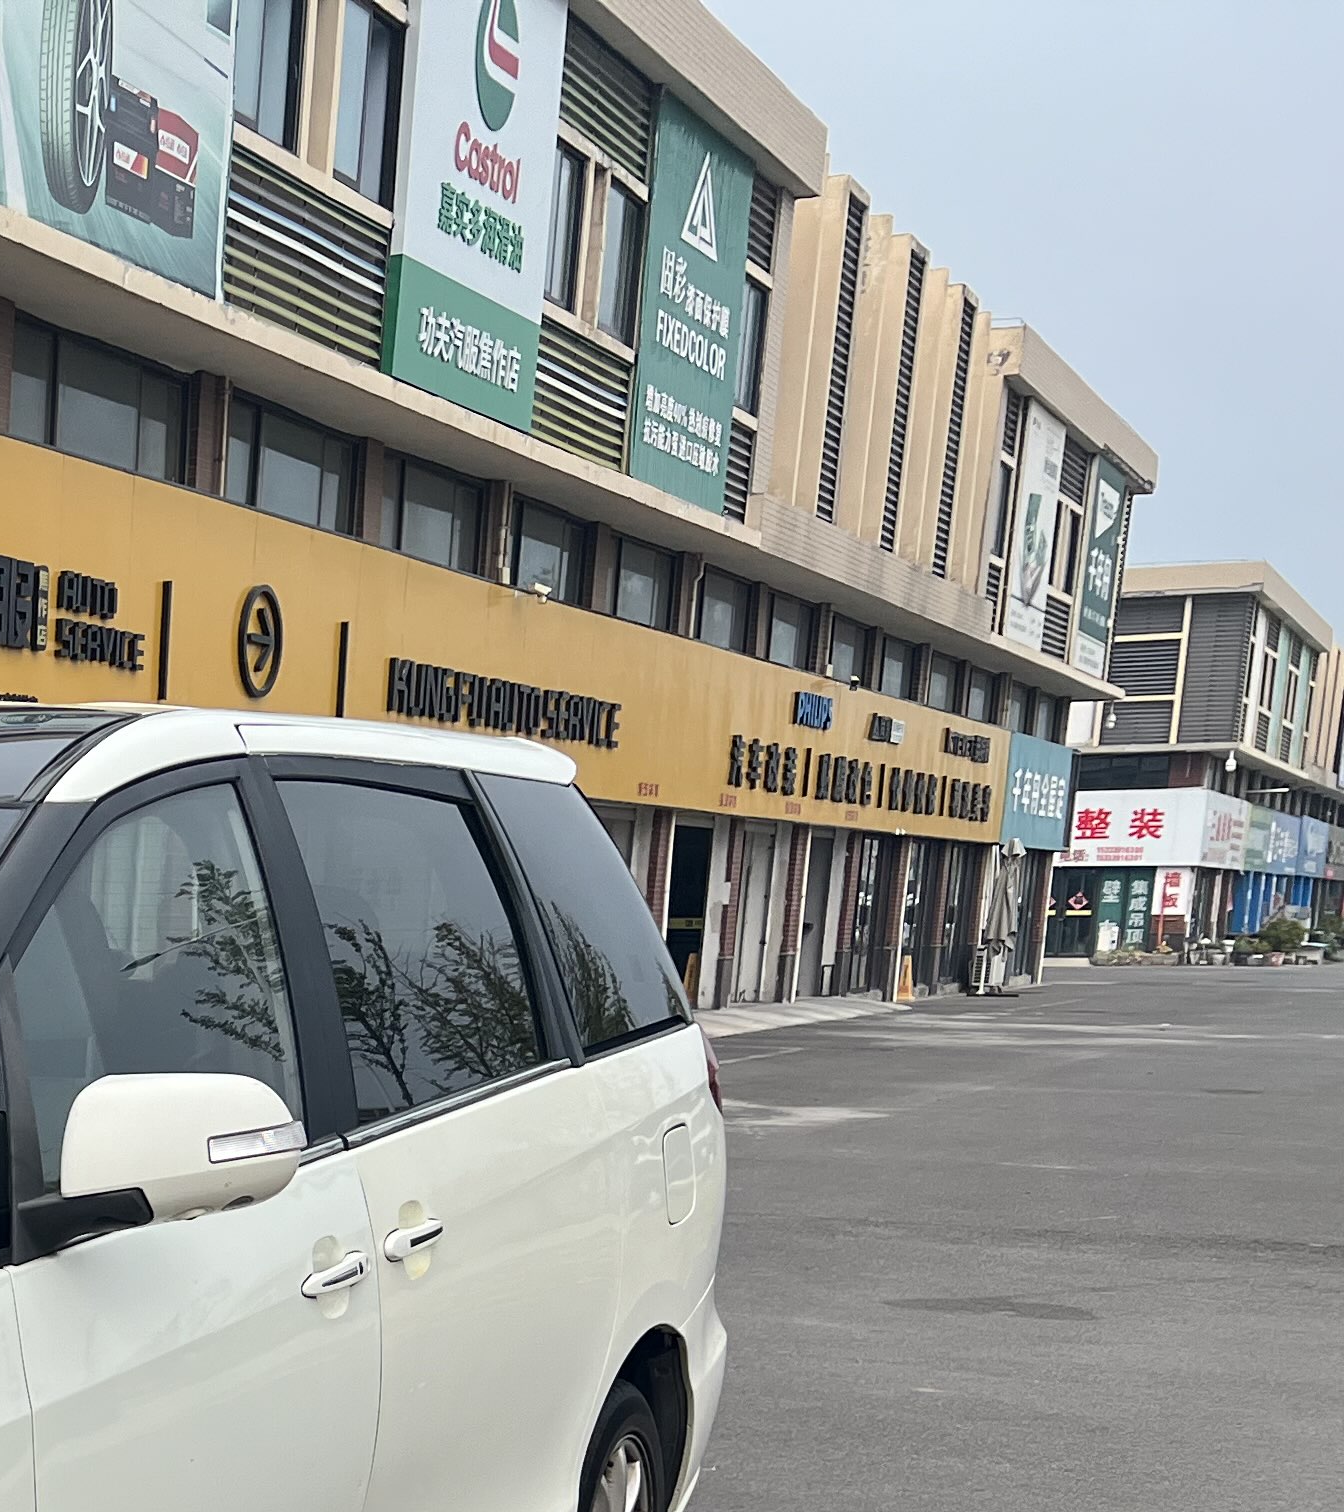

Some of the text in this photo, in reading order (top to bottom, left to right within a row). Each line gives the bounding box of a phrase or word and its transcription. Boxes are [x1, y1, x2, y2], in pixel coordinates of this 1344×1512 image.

[454, 121, 521, 204] Castrol
[437, 181, 524, 273] 嘉实多润滑油
[418, 306, 521, 393] 功夫汽服焦作店
[656, 309, 726, 381] FIXEDCOLOR
[57, 570, 119, 619] AUTO
[55, 617, 145, 670] SERVICE
[541, 690, 622, 749] SERVICE
[793, 692, 833, 731] PHILIPS
[1075, 808, 1164, 839] 整装
[1125, 880, 1149, 944] 集成吊顶
